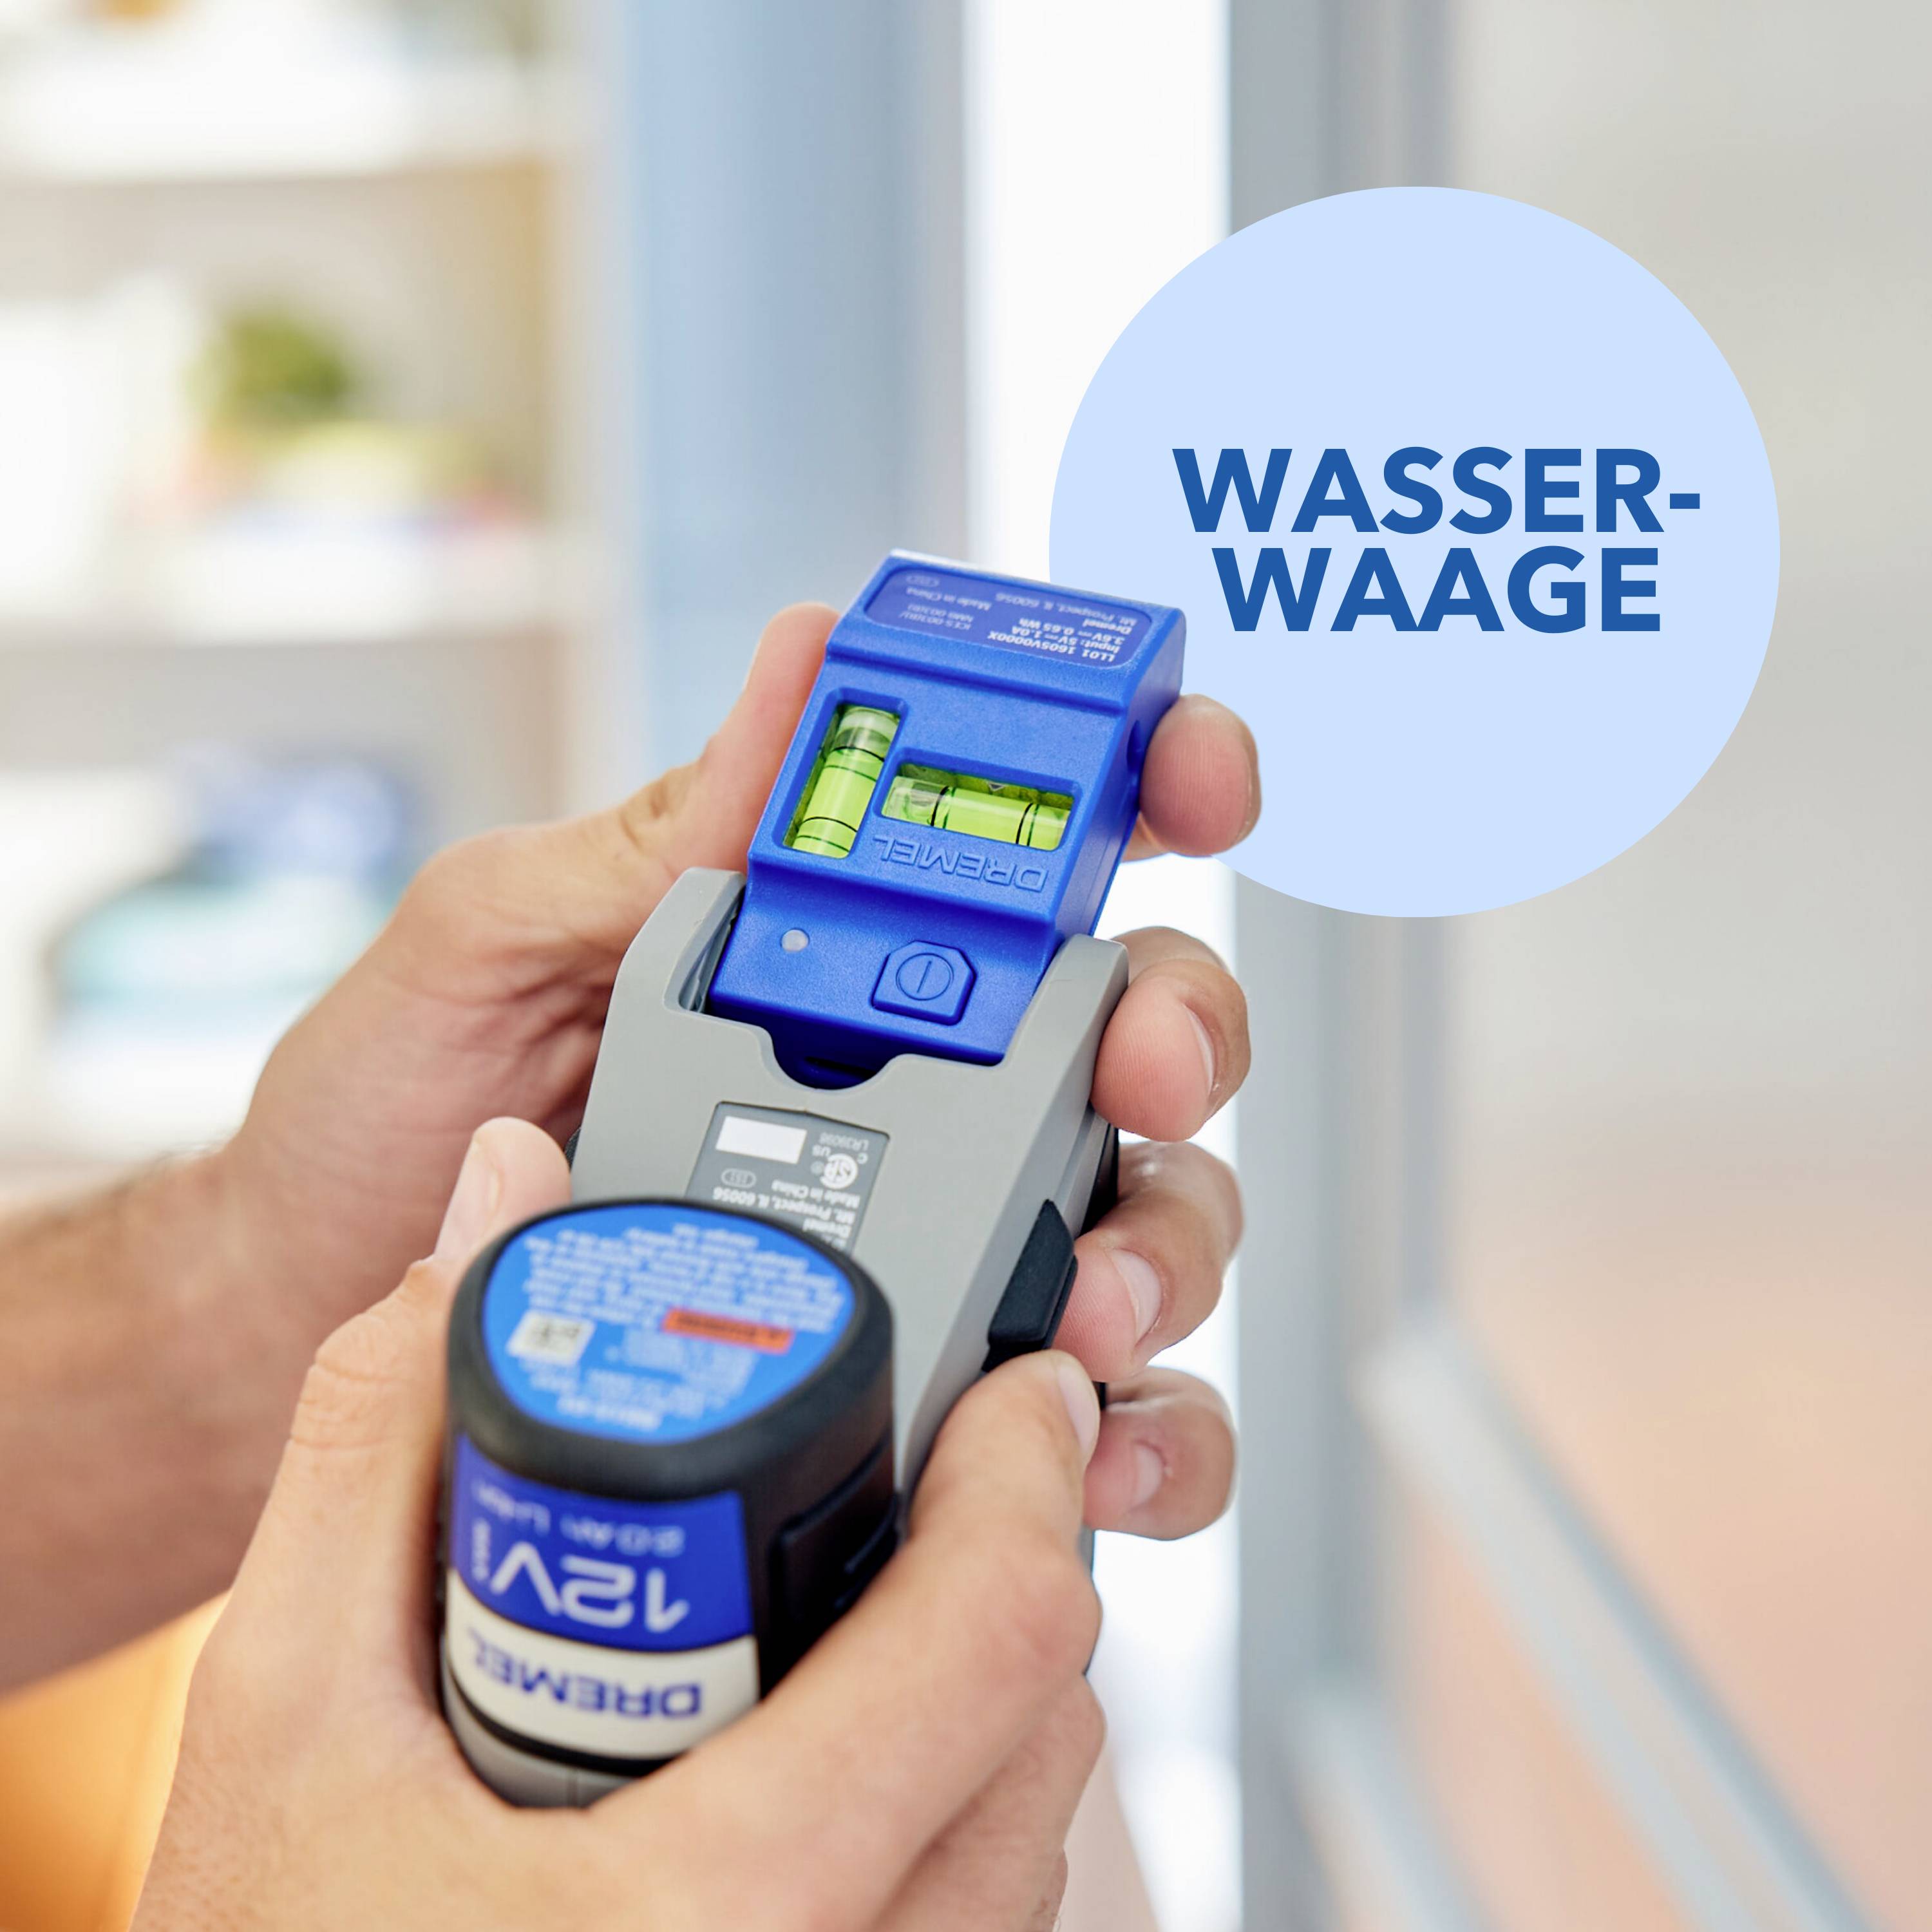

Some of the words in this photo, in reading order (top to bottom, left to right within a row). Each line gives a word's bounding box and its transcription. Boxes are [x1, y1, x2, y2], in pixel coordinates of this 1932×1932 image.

[905, 587, 941, 601] China
[943, 594, 954, 603] in
[996, 592, 1039, 608] 60056
[958, 598, 992, 611] Made
[1083, 619, 1132, 635] Dremel
[1081, 639, 1120, 654] Input:
[873, 835, 1048, 893] DREMEL
[713, 1187, 756, 1206] 60056
[772, 1180, 809, 1199] China
[811, 1188, 823, 1201] in
[824, 1189, 860, 1208] Made
[803, 1218, 851, 1238] Dremel
[468, 1625, 701, 1718] DREMEL
